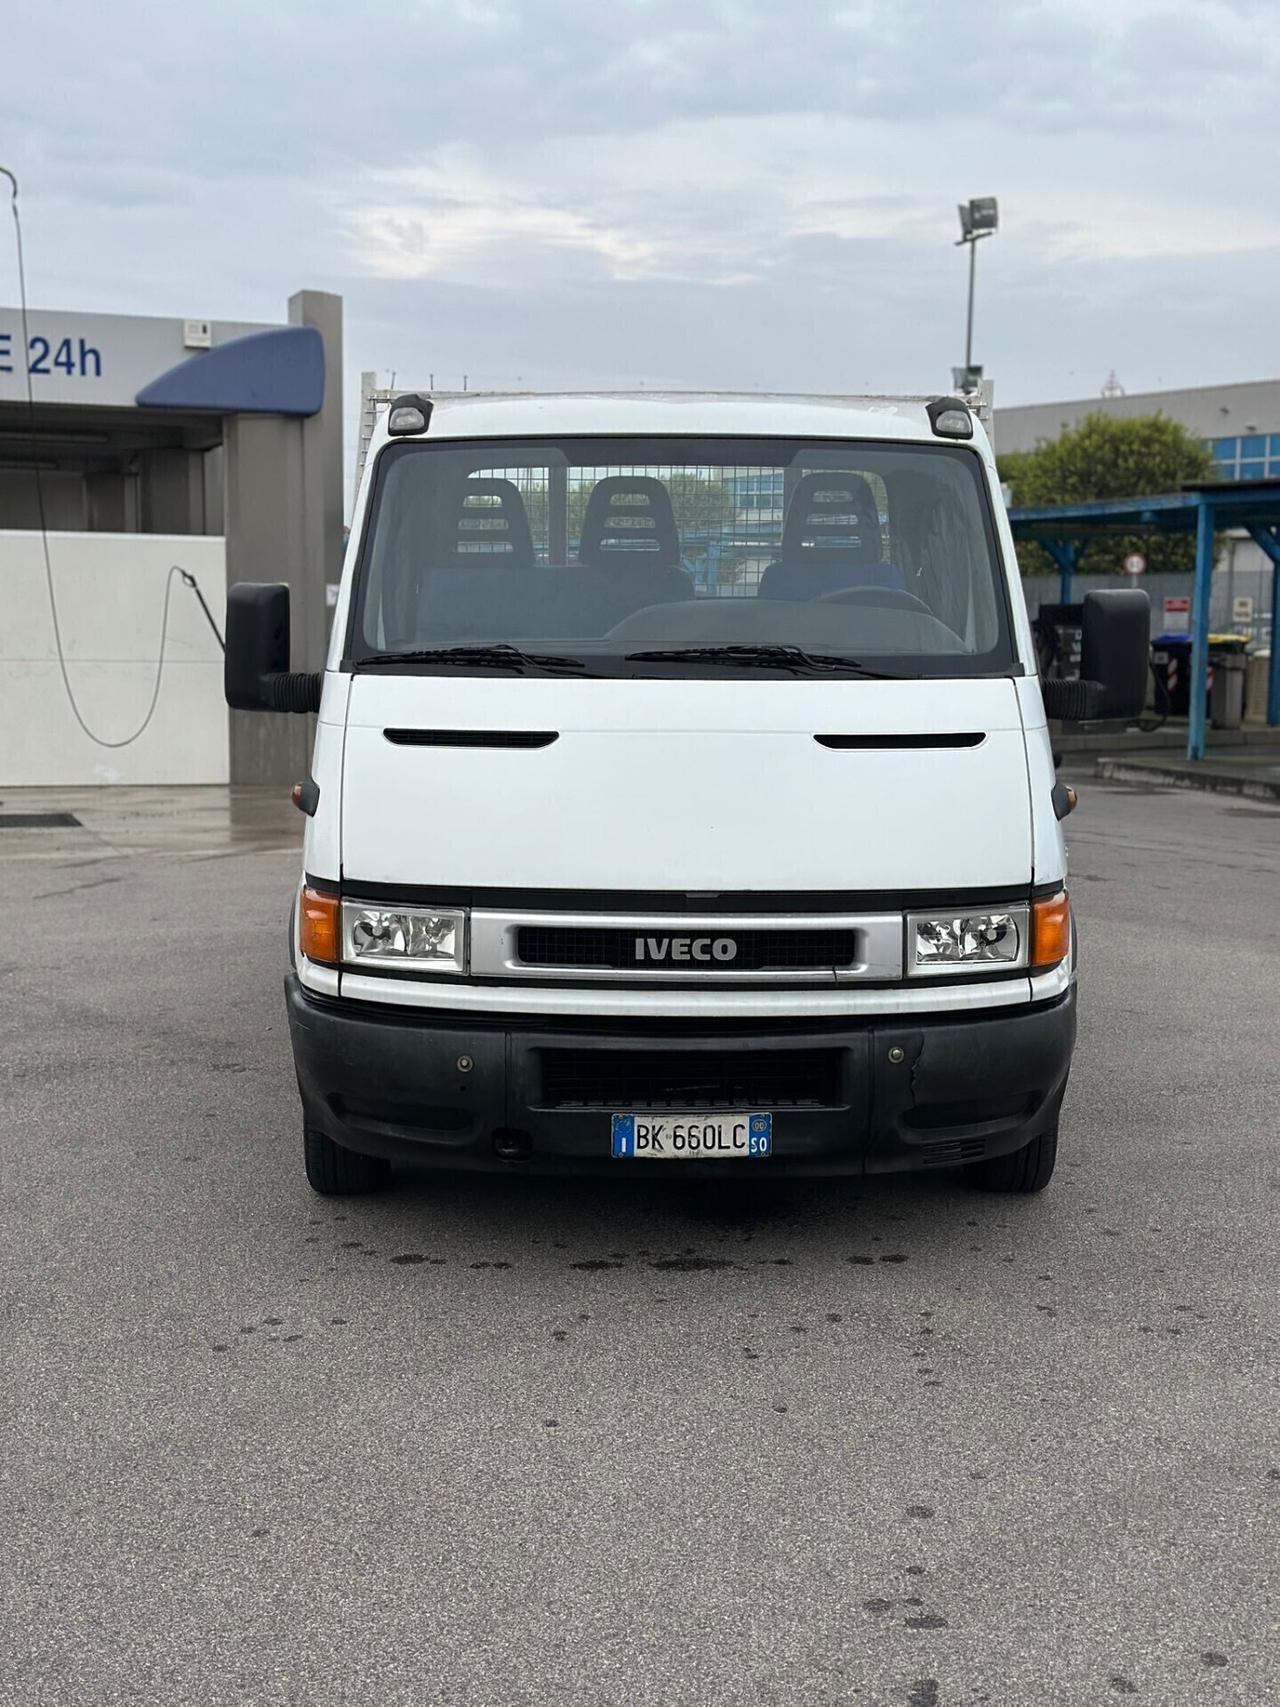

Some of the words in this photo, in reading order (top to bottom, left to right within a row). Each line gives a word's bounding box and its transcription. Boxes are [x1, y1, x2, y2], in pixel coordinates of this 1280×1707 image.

[28, 336, 101, 376] 24h
[635, 938, 737, 960] IVECO
[637, 1124, 664, 1150] BK
[672, 1124, 746, 1150] 660LC
[750, 1136, 768, 1152] SO
